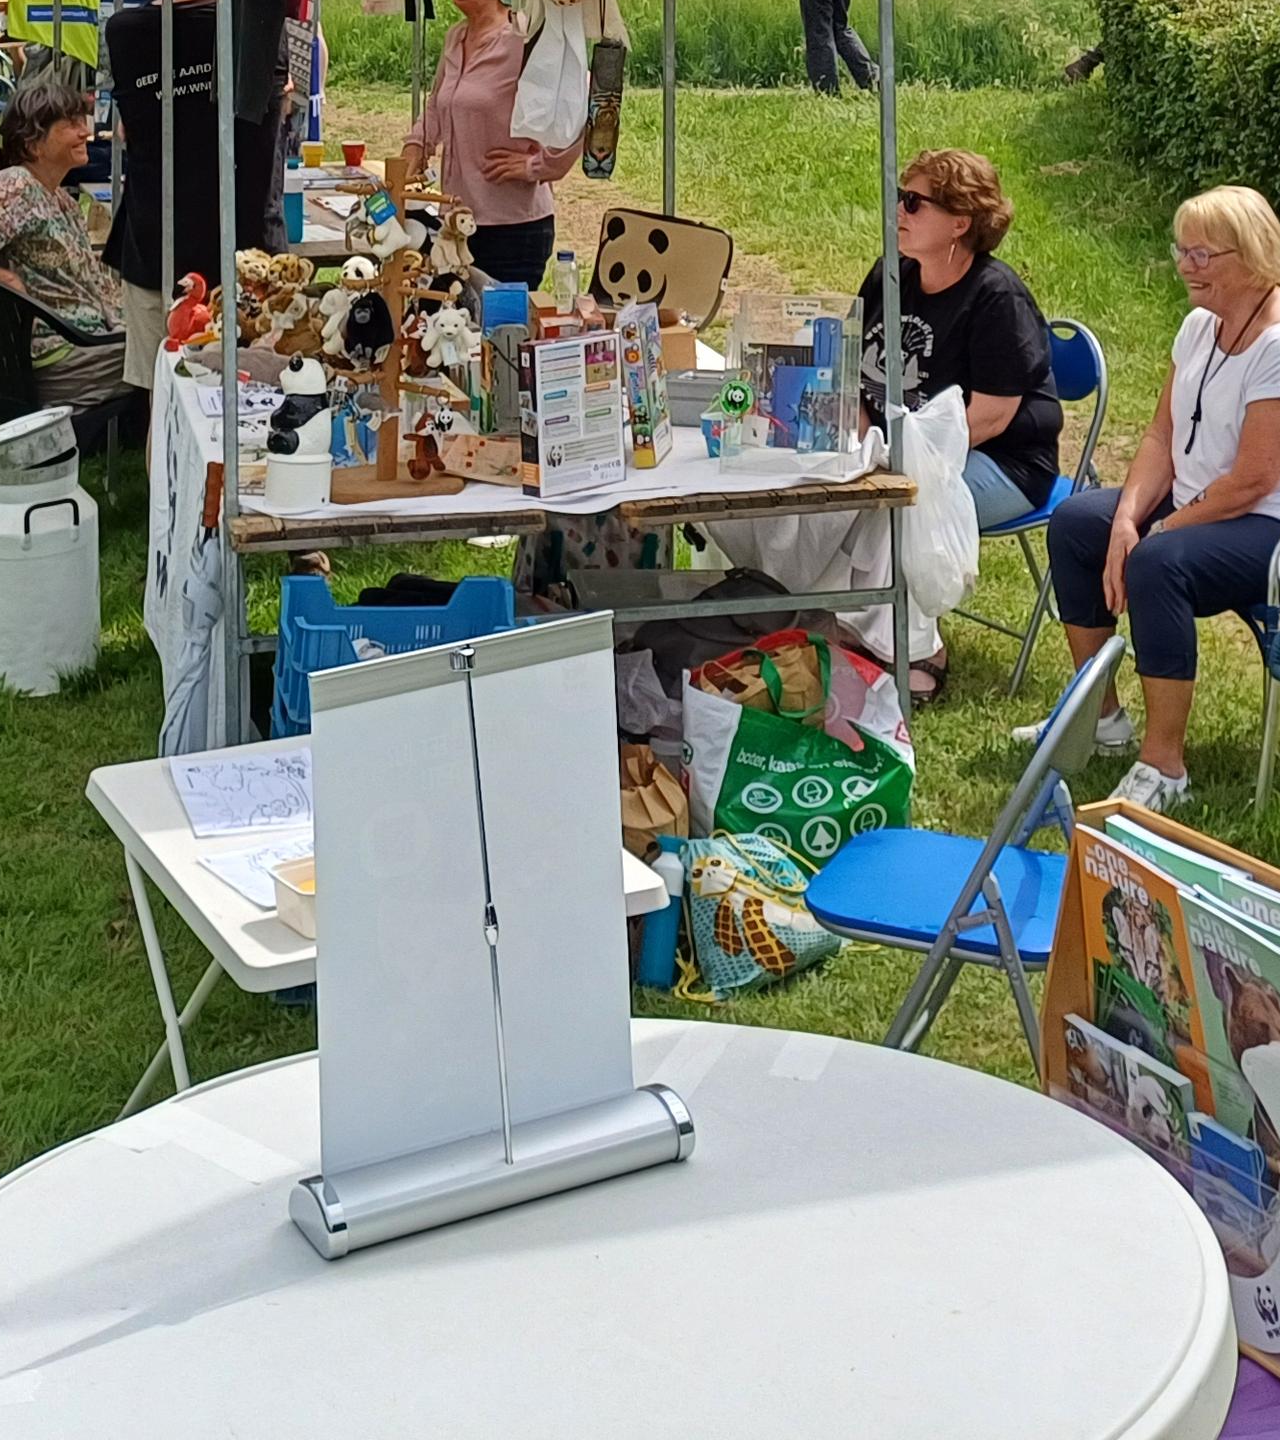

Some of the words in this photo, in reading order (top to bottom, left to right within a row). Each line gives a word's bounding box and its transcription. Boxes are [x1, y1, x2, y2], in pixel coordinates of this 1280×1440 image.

[179, 63, 212, 78] AARD
[1094, 844, 1129, 876] one
[1085, 855, 1149, 907] nature
[1199, 913, 1237, 947] one
[1190, 924, 1262, 978] nature
